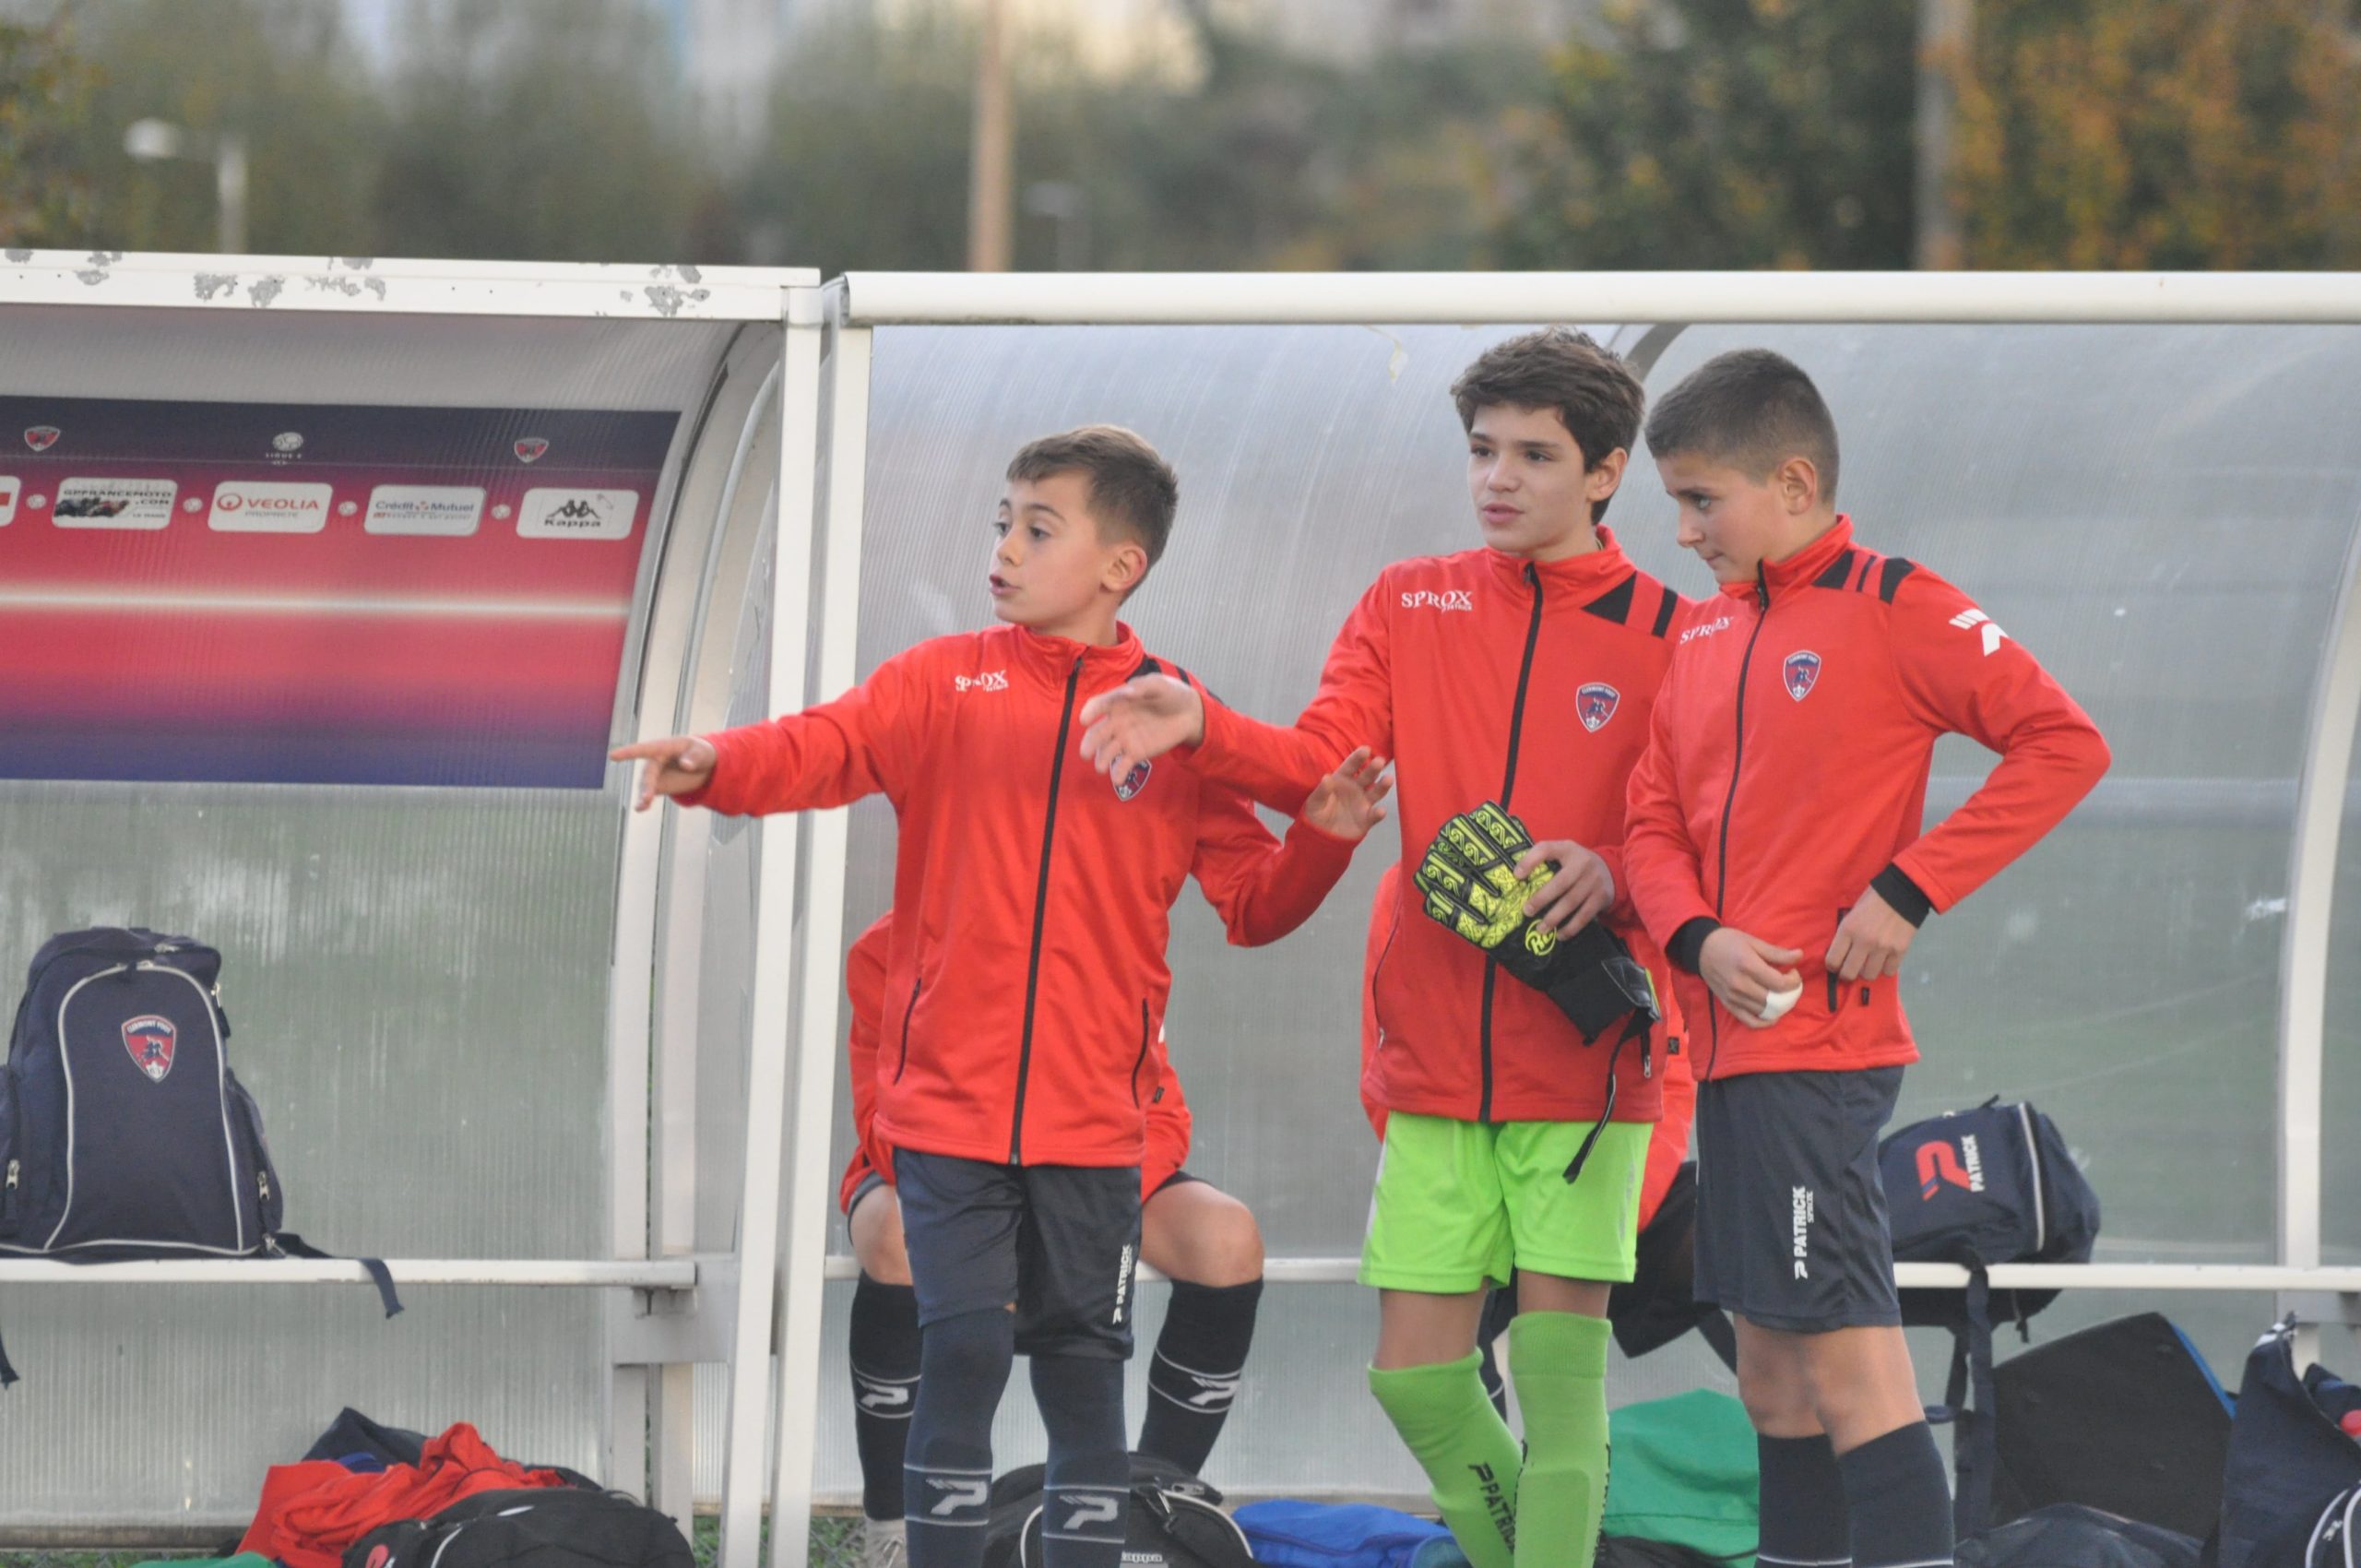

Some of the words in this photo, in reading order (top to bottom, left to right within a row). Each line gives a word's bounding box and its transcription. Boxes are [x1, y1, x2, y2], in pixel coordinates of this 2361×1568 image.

[247, 497, 319, 510] VEOLIA
[430, 503, 475, 513] Mutuel
[544, 518, 601, 528] Kappa
[1401, 589, 1473, 610] SPROX
[1961, 1134, 1985, 1192] PATRICK
[1792, 1185, 1807, 1257] PATRICK
[1116, 1243, 1131, 1304] PATRICK
